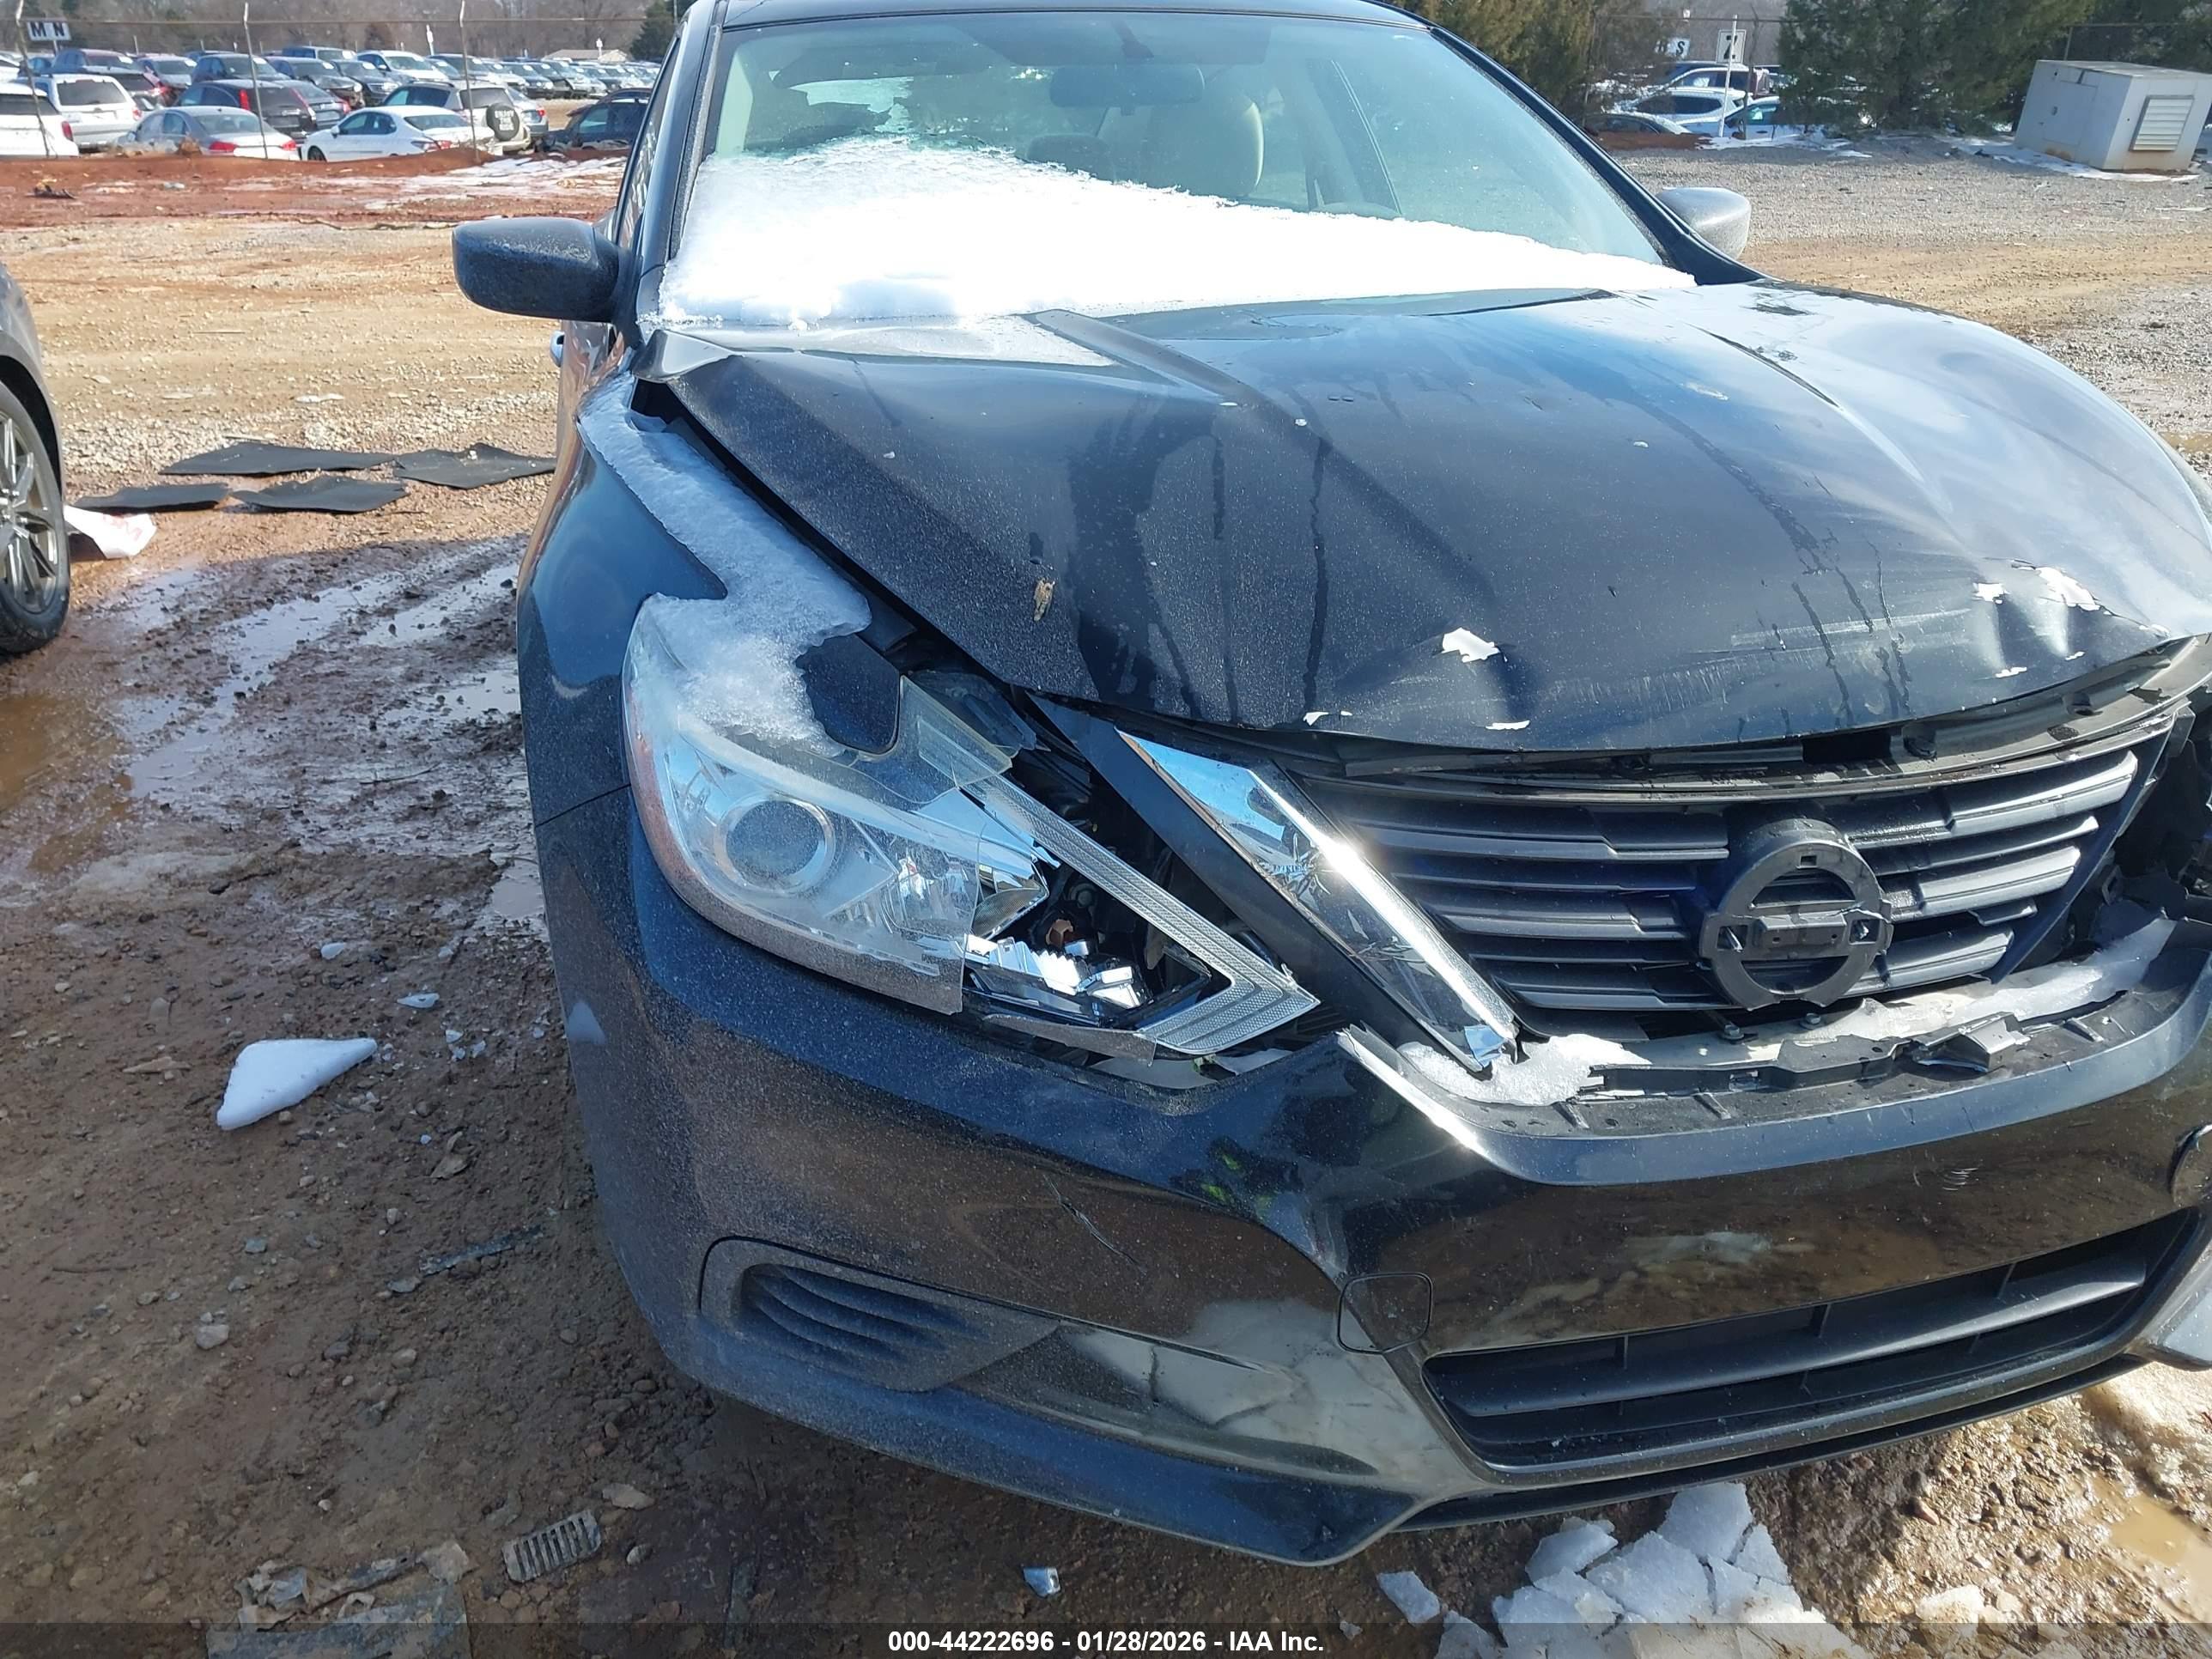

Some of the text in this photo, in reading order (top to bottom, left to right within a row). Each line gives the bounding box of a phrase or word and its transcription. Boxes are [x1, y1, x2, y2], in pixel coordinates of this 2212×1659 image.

[29, 21, 65, 37] M N
[1676, 40, 1686, 55] S
